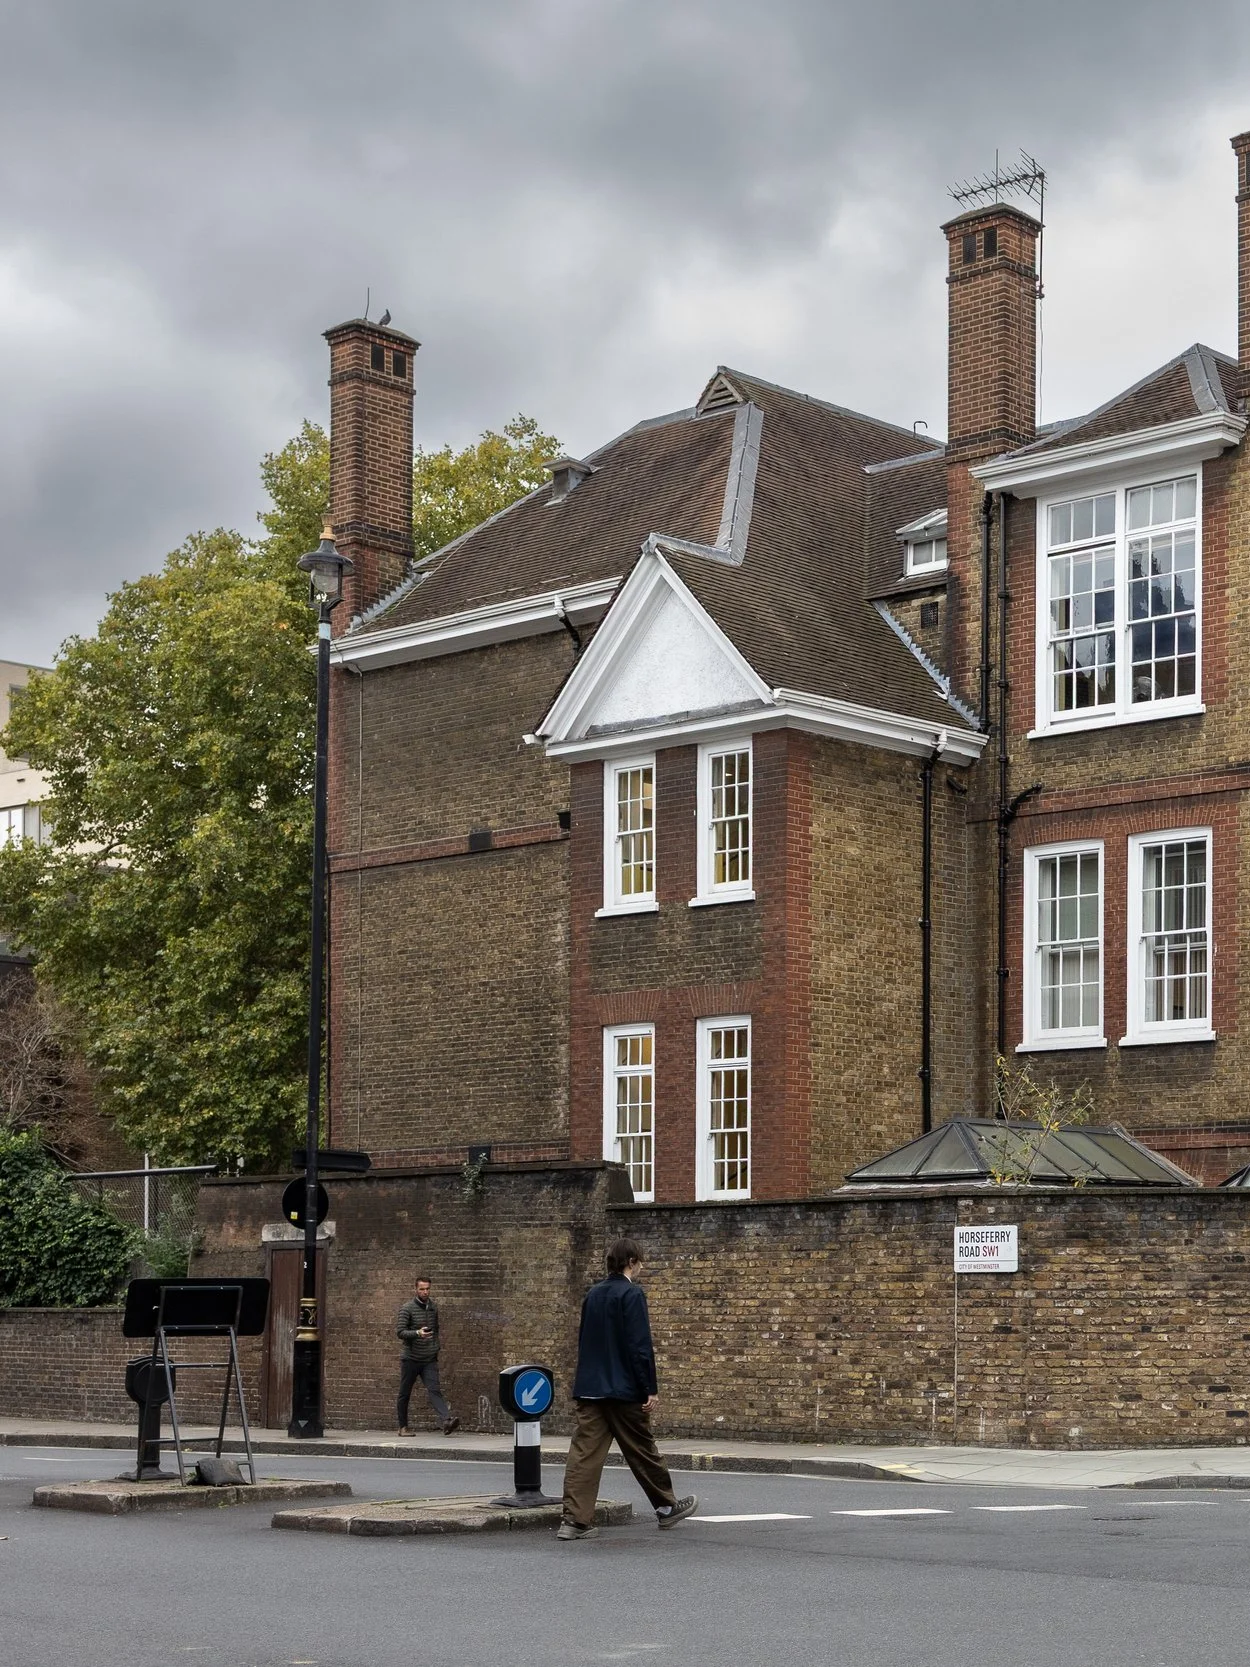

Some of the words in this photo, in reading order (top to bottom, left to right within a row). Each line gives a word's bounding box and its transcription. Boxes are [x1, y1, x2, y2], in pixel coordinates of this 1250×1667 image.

[959, 1231, 1011, 1243] HORSEFERRY
[959, 1245, 981, 1257] ROAD
[982, 1245, 999, 1257] SW1
